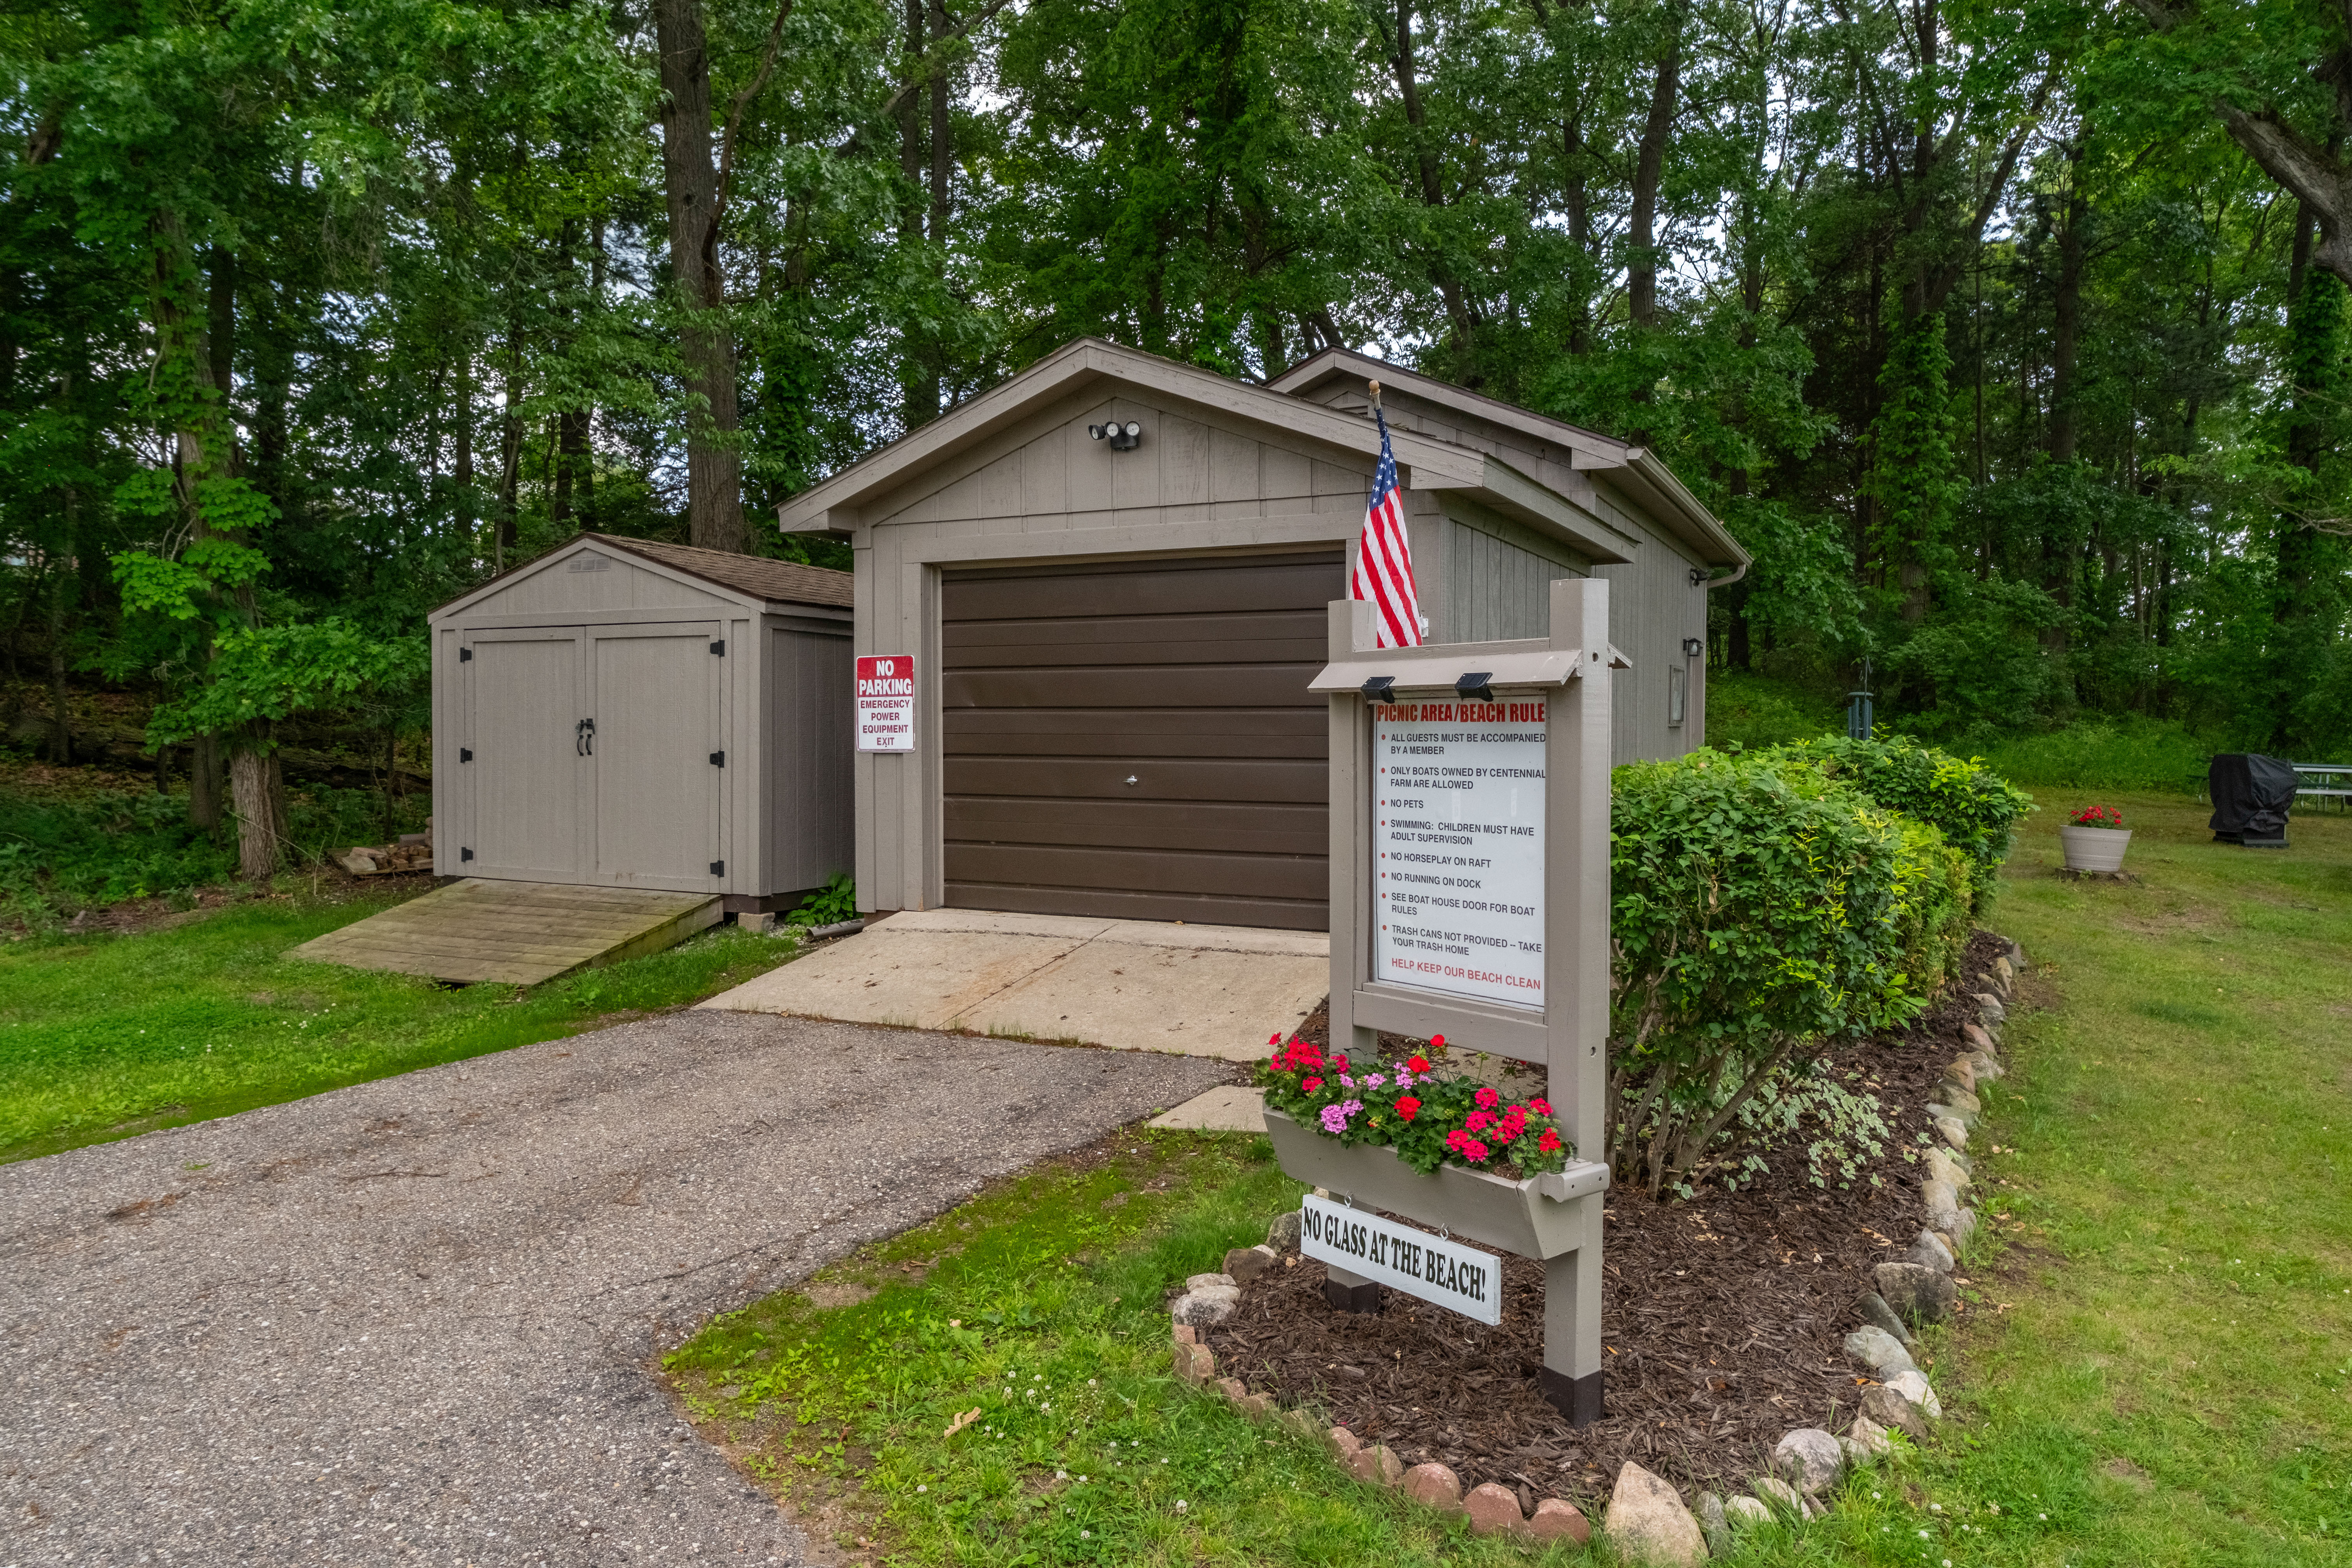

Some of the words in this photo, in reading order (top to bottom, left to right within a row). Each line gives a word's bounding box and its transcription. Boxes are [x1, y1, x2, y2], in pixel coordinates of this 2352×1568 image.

[876, 660, 894, 676] NO
[859, 679, 912, 695] PARKING
[860, 700, 910, 708] EMERGENCY
[871, 713, 899, 721] POWER
[1377, 704, 1418, 721] PICNIC
[863, 725, 908, 733] EQUIPMENT
[1391, 734, 1405, 742] ALL
[1441, 734, 1464, 742] MUST
[1467, 734, 1478, 742] BE
[1480, 734, 1546, 742] ACCOMPANIED
[1391, 767, 1410, 775] ONLY
[1413, 767, 1439, 776] BOATS
[1442, 768, 1473, 776] OWNED
[1476, 769, 1487, 777] BY
[1490, 769, 1546, 778] CENTENNIAL
[1391, 779, 1411, 787] FARM
[1413, 780, 1429, 788] ARE
[1432, 781, 1473, 789] ALLOWED
[1404, 800, 1423, 808] PETS
[1391, 820, 1433, 830] SWIMMING:
[1438, 822, 1481, 833] CHILDREN
[1483, 825, 1508, 834] MUST
[1511, 826, 1534, 836] HAVE
[1391, 832, 1415, 841] ADULT
[1418, 834, 1472, 845] SUPERVISION
[1391, 852, 1402, 861] NO
[1404, 853, 1451, 864] HORSEPLAY
[1454, 857, 1466, 866] ON
[1469, 858, 1491, 868] RAFT
[1391, 873, 1402, 881] NO
[1404, 874, 1440, 885] RUNNING
[1442, 877, 1455, 885] ON
[1457, 878, 1481, 889] DOCK
[1391, 892, 1406, 901] SEE
[1409, 894, 1429, 904] BOAT
[1432, 897, 1460, 908] HOUSE
[1462, 900, 1487, 911] DOOR
[1490, 903, 1507, 913] FOR
[1511, 905, 1535, 916] BOAT
[1392, 905, 1417, 915] RULES
[1392, 925, 1418, 935] TRASH
[1420, 929, 1442, 939] CANS
[1444, 932, 1461, 942] NOT
[1464, 934, 1507, 947] PROVIDED
[1518, 942, 1542, 952] TAKE
[1393, 937, 1414, 947] YOUR
[1416, 940, 1442, 952] TRASH
[1445, 945, 1469, 956] HOME
[1392, 958, 1414, 970] HELP
[1417, 962, 1442, 973] KEEP
[1444, 966, 1465, 978] OUR
[1467, 970, 1502, 984] BEACH
[1505, 975, 1541, 989] CLEAN
[1303, 1206, 1321, 1241] NO
[1325, 1215, 1366, 1258] GLASS
[1369, 1230, 1388, 1266] AT
[1391, 1236, 1421, 1279] THE
[1425, 1249, 1486, 1303] BEACH!
